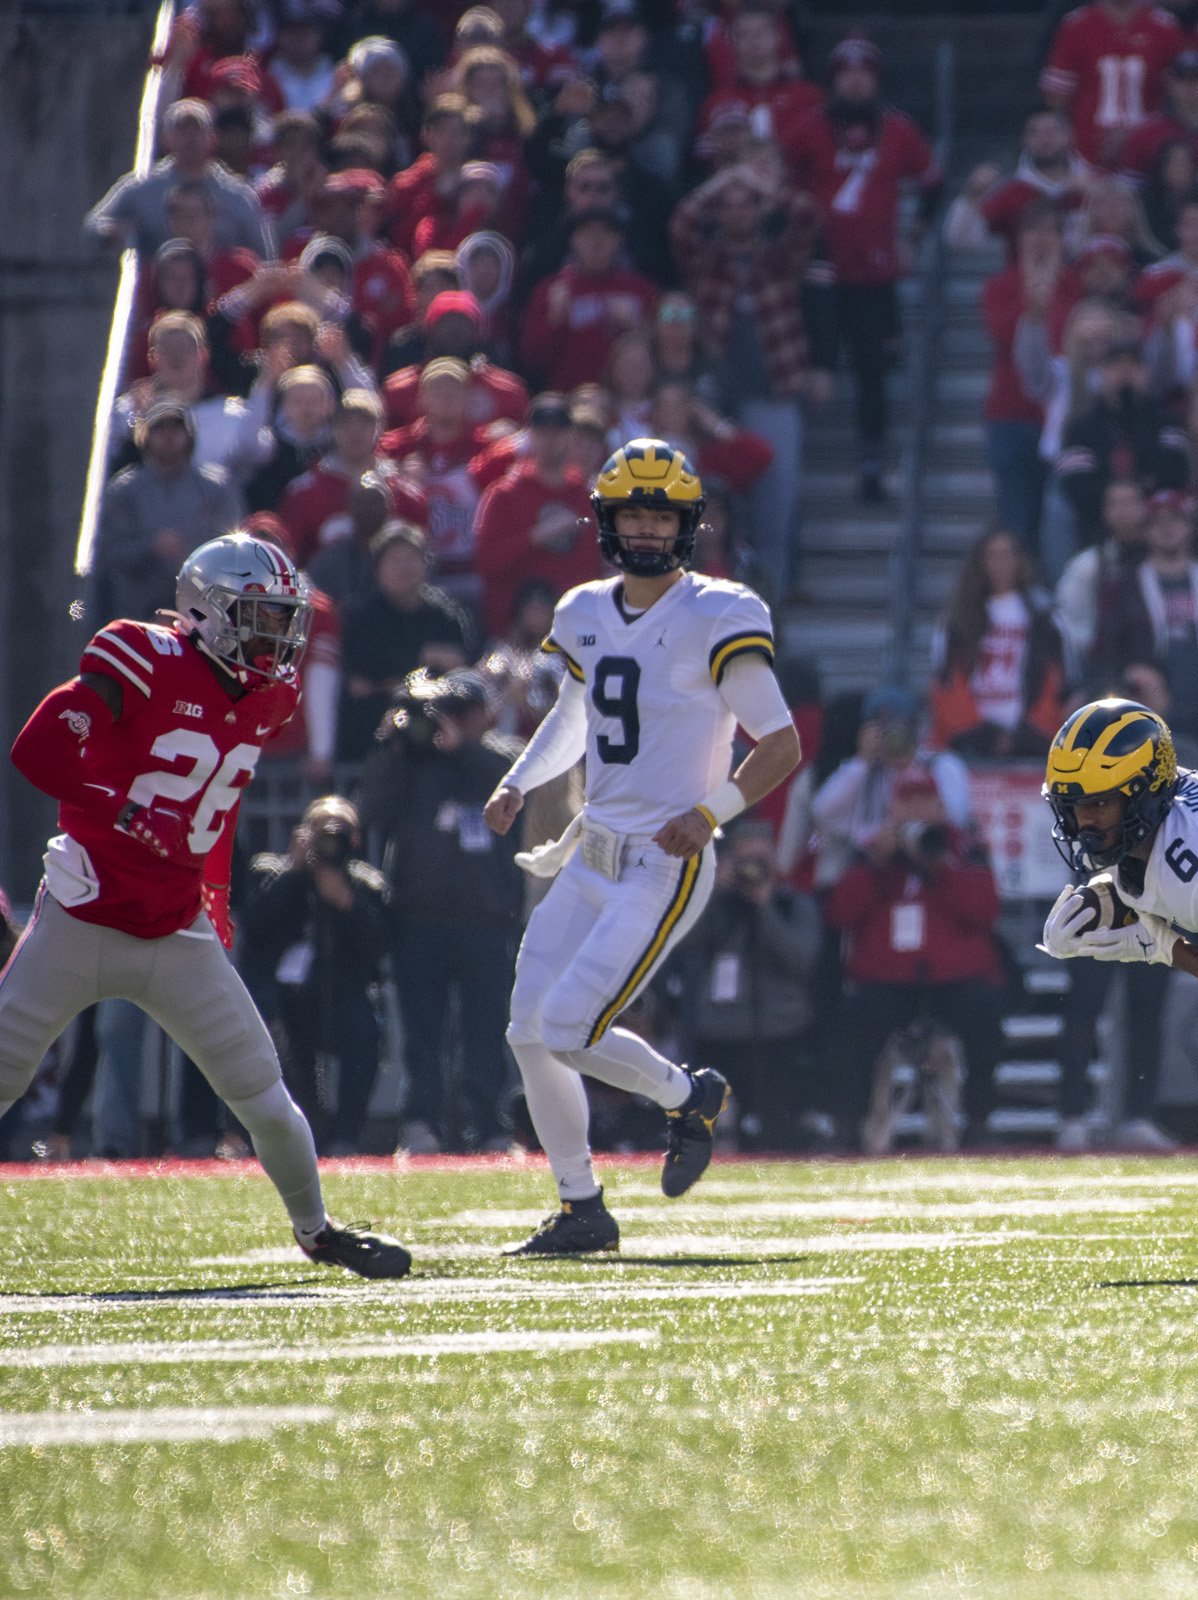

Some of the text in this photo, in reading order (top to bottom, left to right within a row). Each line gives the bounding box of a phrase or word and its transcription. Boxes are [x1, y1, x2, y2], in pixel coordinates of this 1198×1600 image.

[1096, 55, 1145, 127] 11
[833, 147, 877, 212] 7
[591, 655, 641, 765] 9
[127, 728, 261, 854] 26
